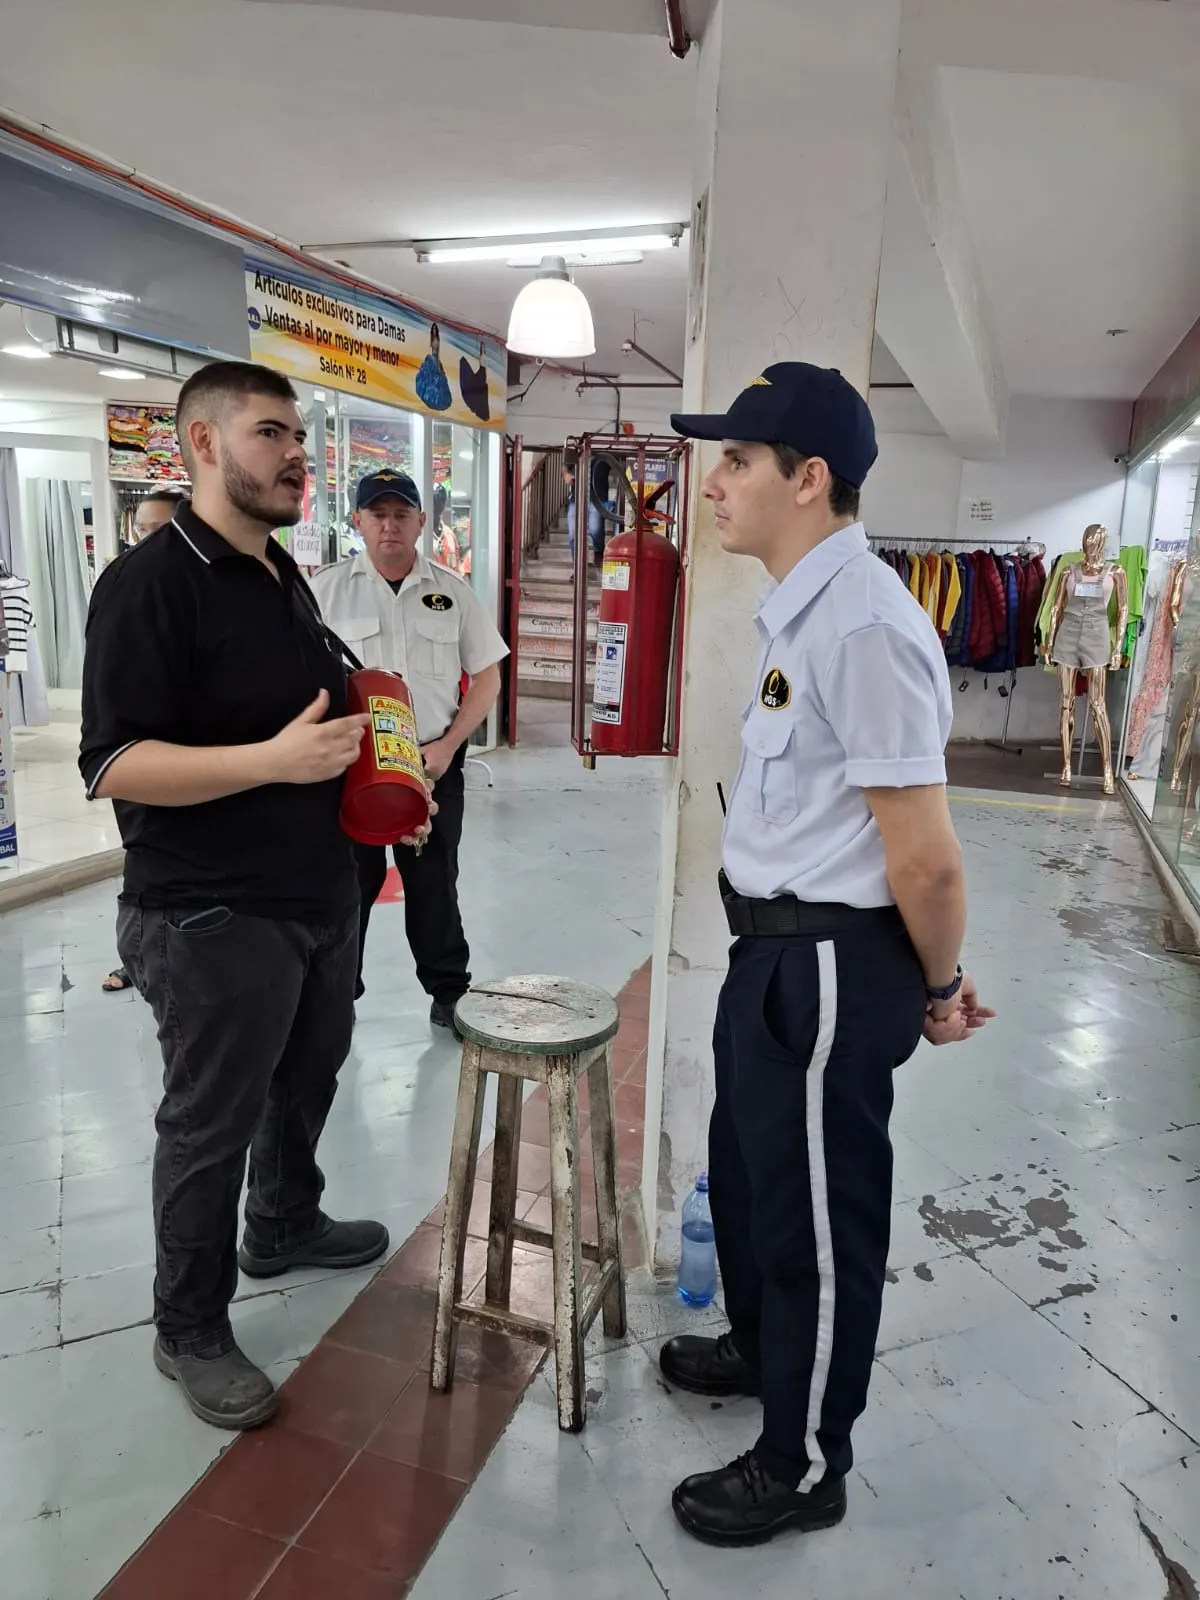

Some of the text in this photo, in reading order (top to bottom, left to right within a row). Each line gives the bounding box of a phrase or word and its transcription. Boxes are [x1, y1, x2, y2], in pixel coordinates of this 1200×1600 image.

[265, 304, 400, 367] Ventas al por mayor y menor
[306, 293, 354, 325] exclusivos
[356, 312, 376, 333] para
[378, 316, 406, 342] Damas
[357, 368, 367, 385] 28
